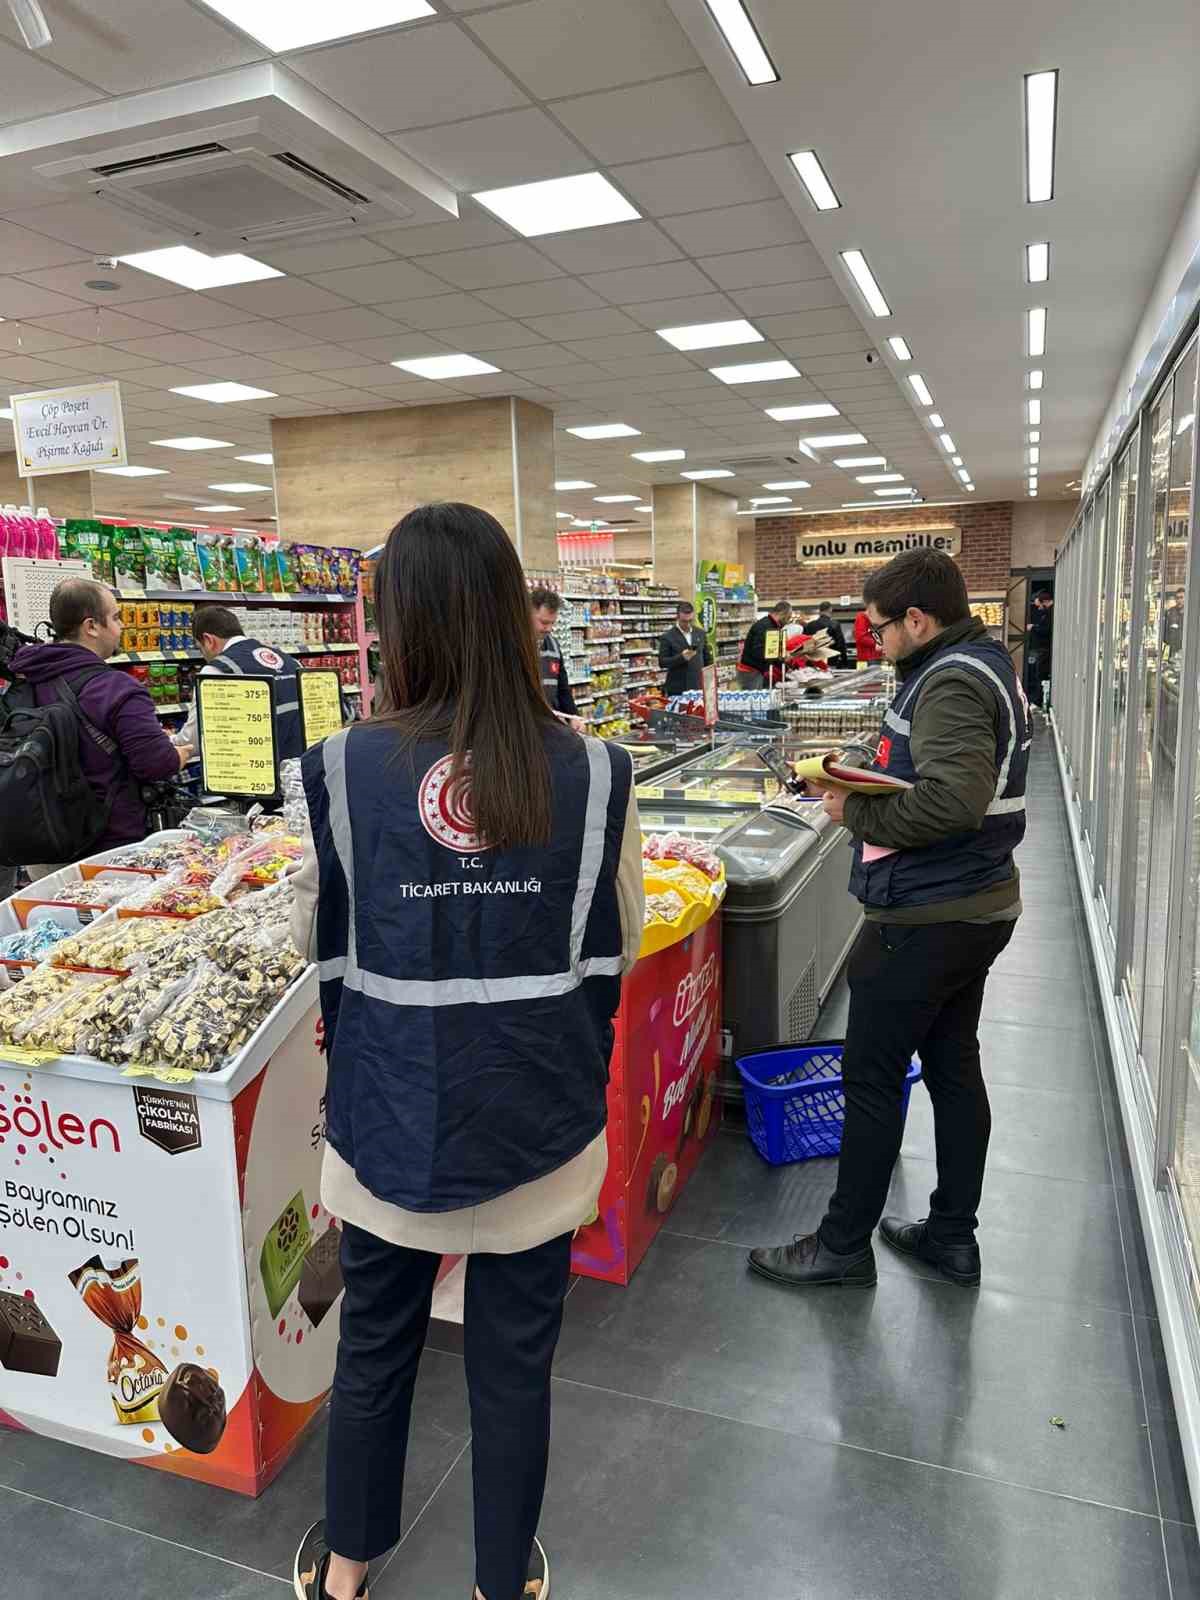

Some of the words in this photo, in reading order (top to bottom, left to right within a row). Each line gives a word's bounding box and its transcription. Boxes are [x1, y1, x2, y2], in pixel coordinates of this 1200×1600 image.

[41, 403, 59, 419] Çöp
[61, 398, 89, 416] Poşeti
[26, 422, 52, 439] Evcil
[53, 420, 89, 438] Hayvan
[37, 443, 70, 460] Pişirme
[72, 436, 104, 457] Kağıdı
[802, 540, 847, 557] unlu
[244, 690, 261, 699] 375
[247, 713, 262, 722] 750
[248, 736, 264, 745] 900
[249, 759, 265, 768] 750
[250, 782, 266, 791] 250
[458, 857, 484, 869] T.C.
[400, 882, 460, 898] TİCARET
[463, 877, 542, 894] BAKANLIĞI
[141, 1094, 190, 1110] TÜRKİYE'NİN
[138, 1103, 198, 1125] ÇİKOLATA
[145, 1118, 193, 1135] FABRİKASI
[5, 1180, 119, 1219] Bayramınız
[0, 1203, 59, 1235] Şölen
[63, 1216, 135, 1251] Olsun!
